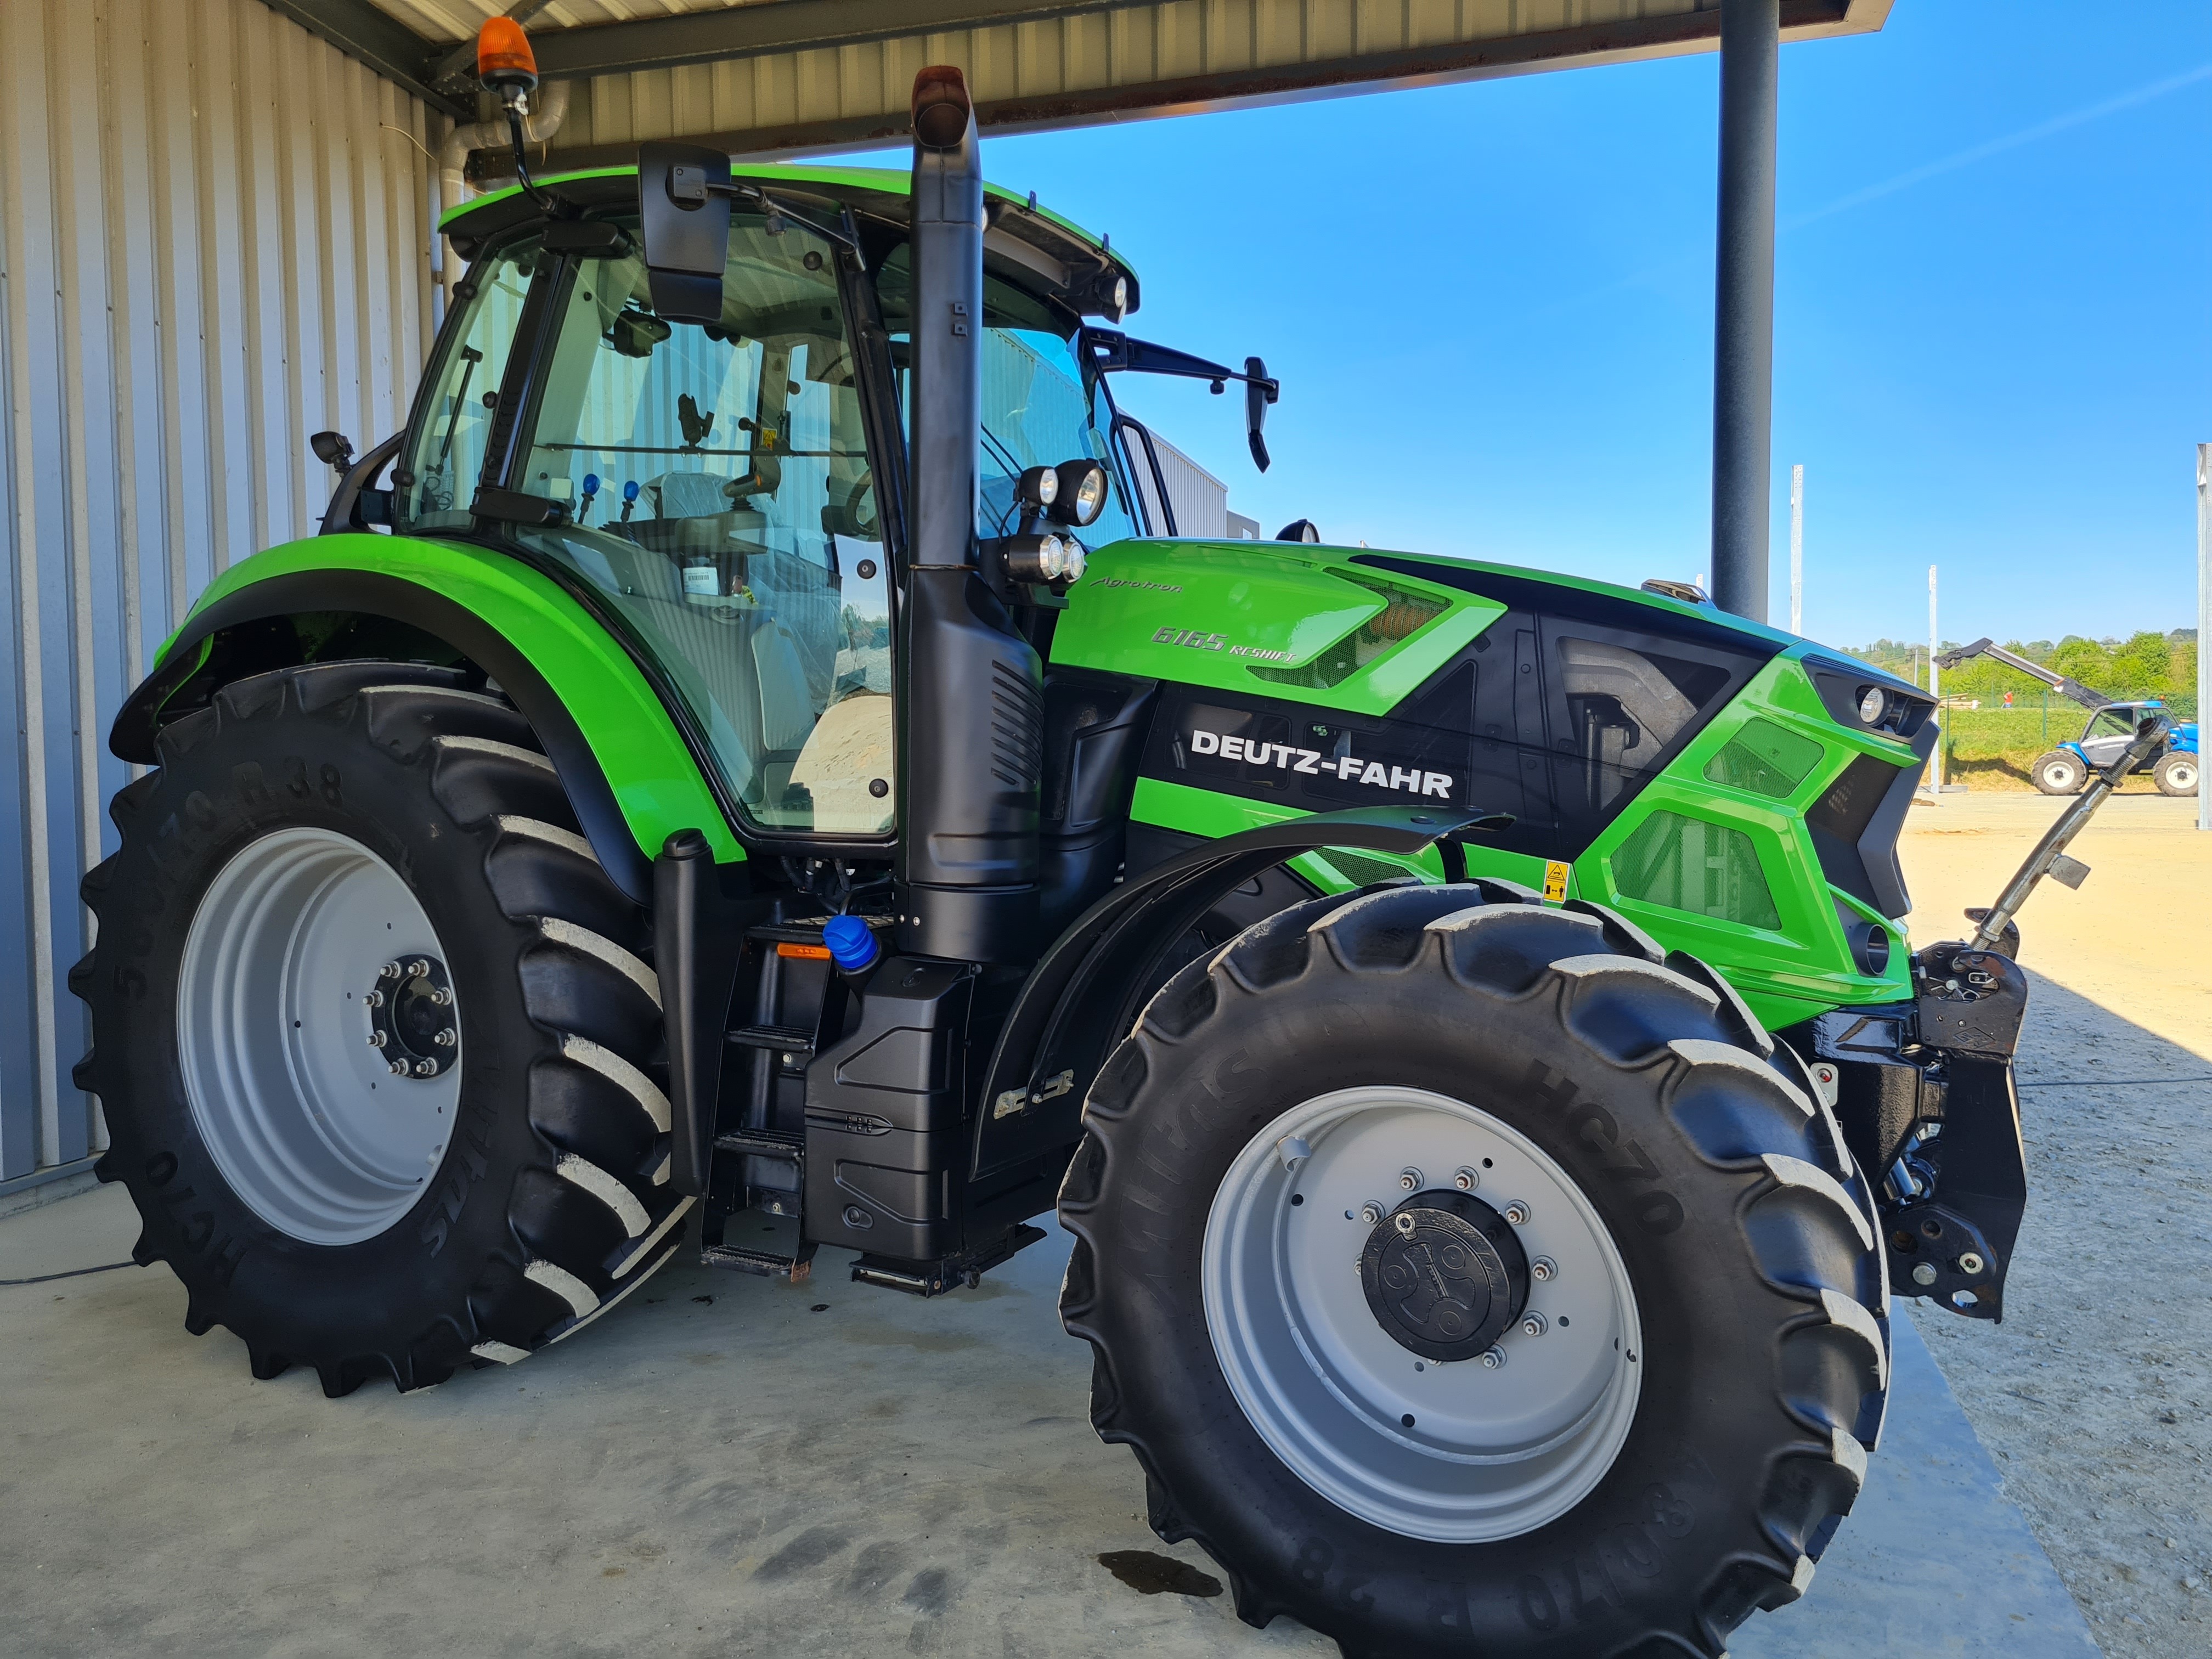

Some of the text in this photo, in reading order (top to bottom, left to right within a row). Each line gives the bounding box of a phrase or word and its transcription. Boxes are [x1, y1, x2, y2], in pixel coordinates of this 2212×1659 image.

[1089, 576, 1183, 593] Agrotron
[1152, 627, 1229, 651] 6165
[283, 755, 344, 808] 38
[1191, 730, 1453, 799] DEUTZ-FAHR
[1516, 1058, 1684, 1235] HC70
